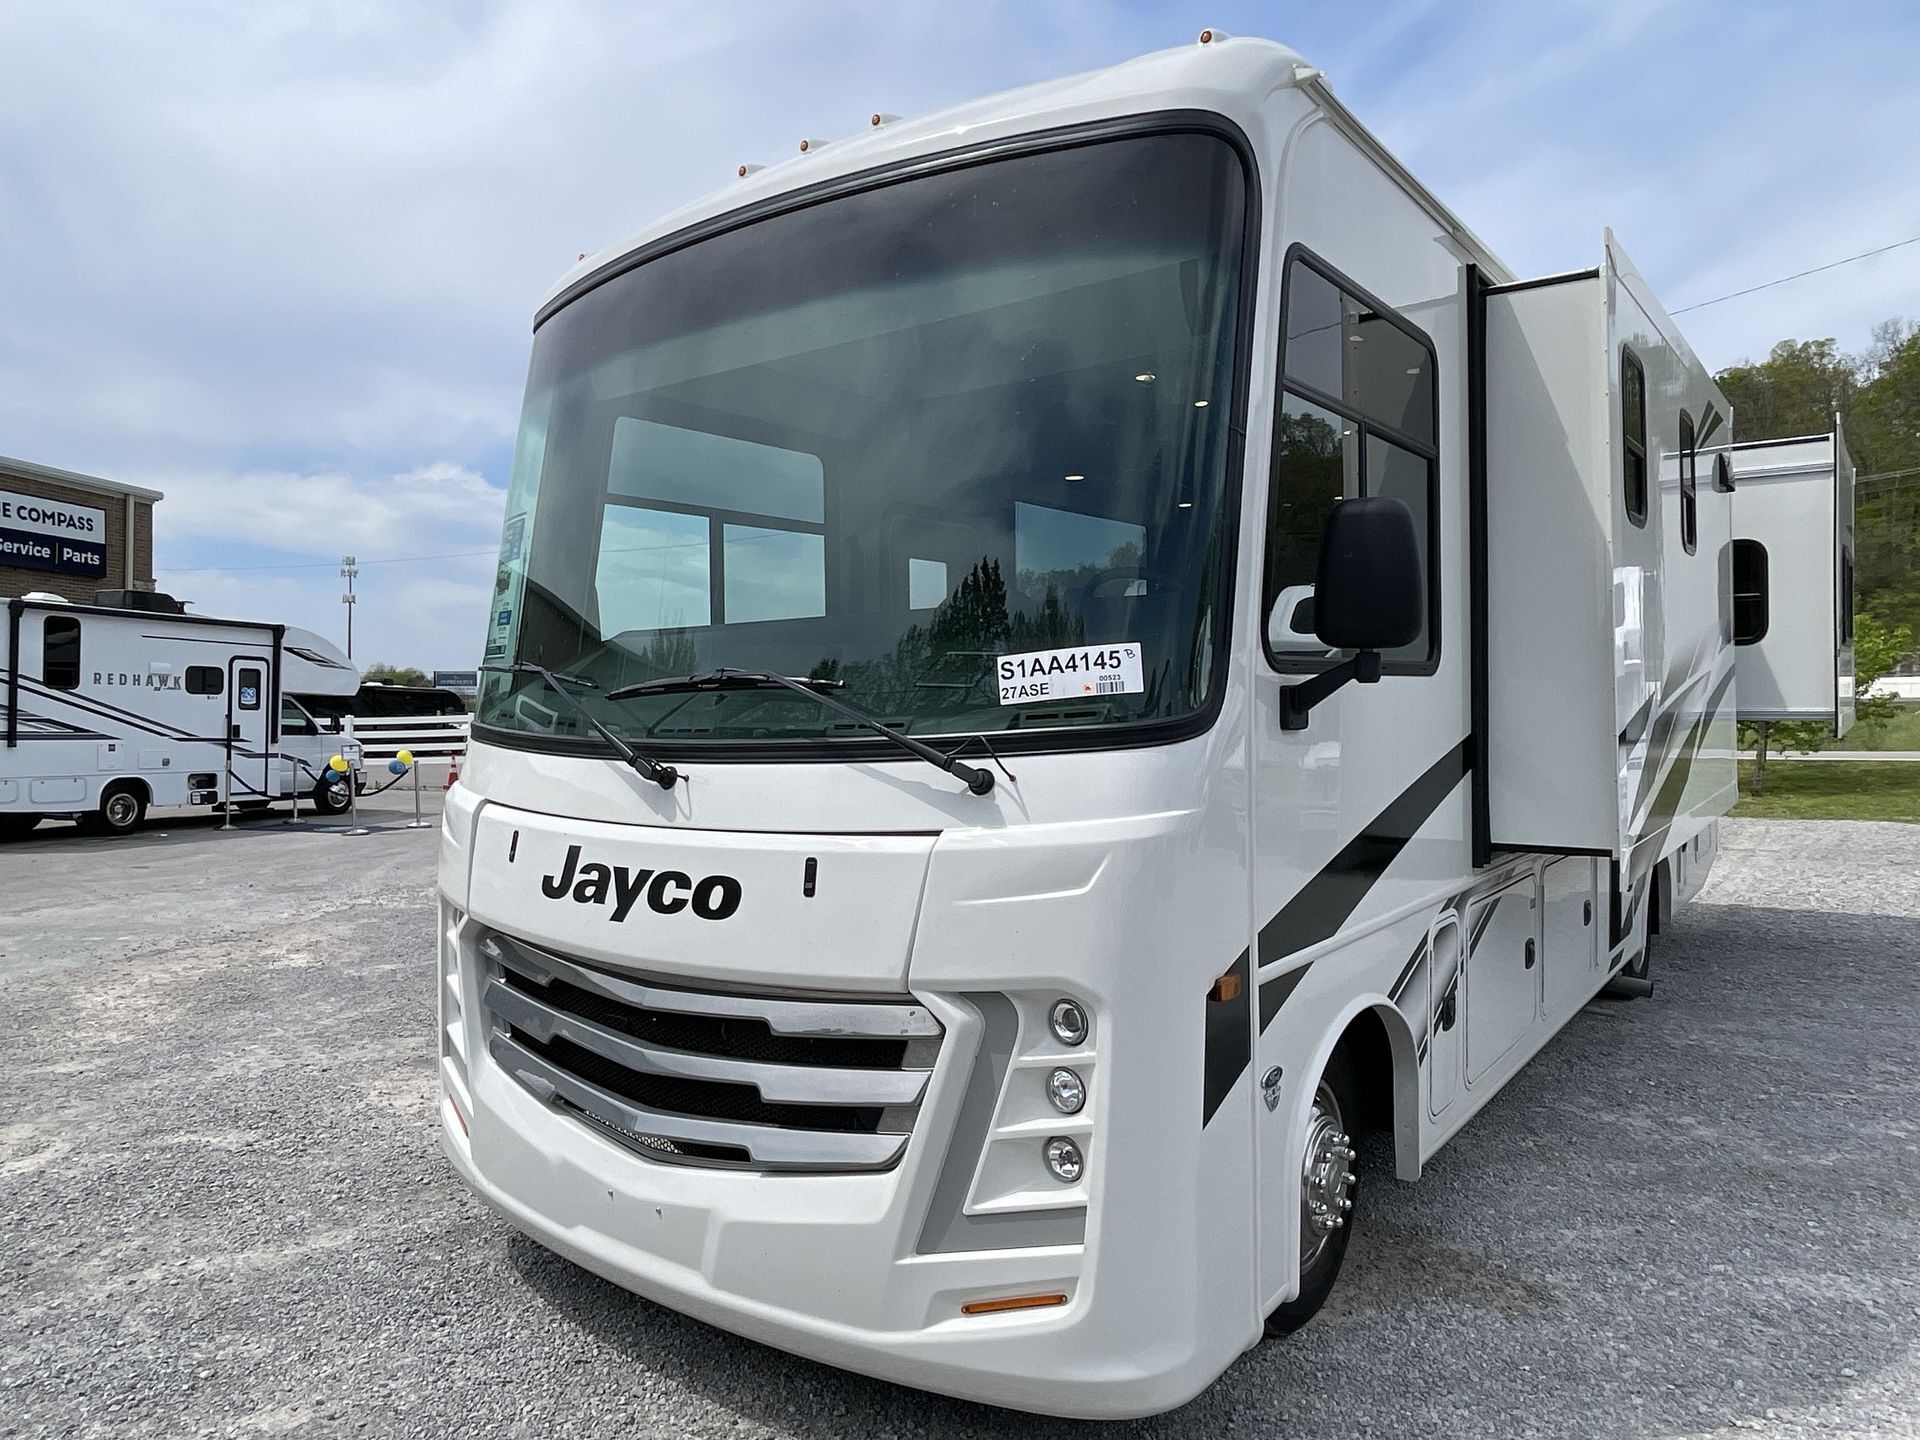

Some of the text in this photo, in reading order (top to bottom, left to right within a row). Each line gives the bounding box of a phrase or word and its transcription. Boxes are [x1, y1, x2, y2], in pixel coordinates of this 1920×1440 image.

[0, 501, 94, 532] E COMPASS
[63, 547, 100, 565] Parts
[1000, 650, 1122, 681] S1AA4145
[93, 672, 182, 689] REDHAWK
[1099, 674, 1121, 682] 00523
[1001, 682, 1050, 700] 27ASE
[541, 844, 743, 923] Jayco
